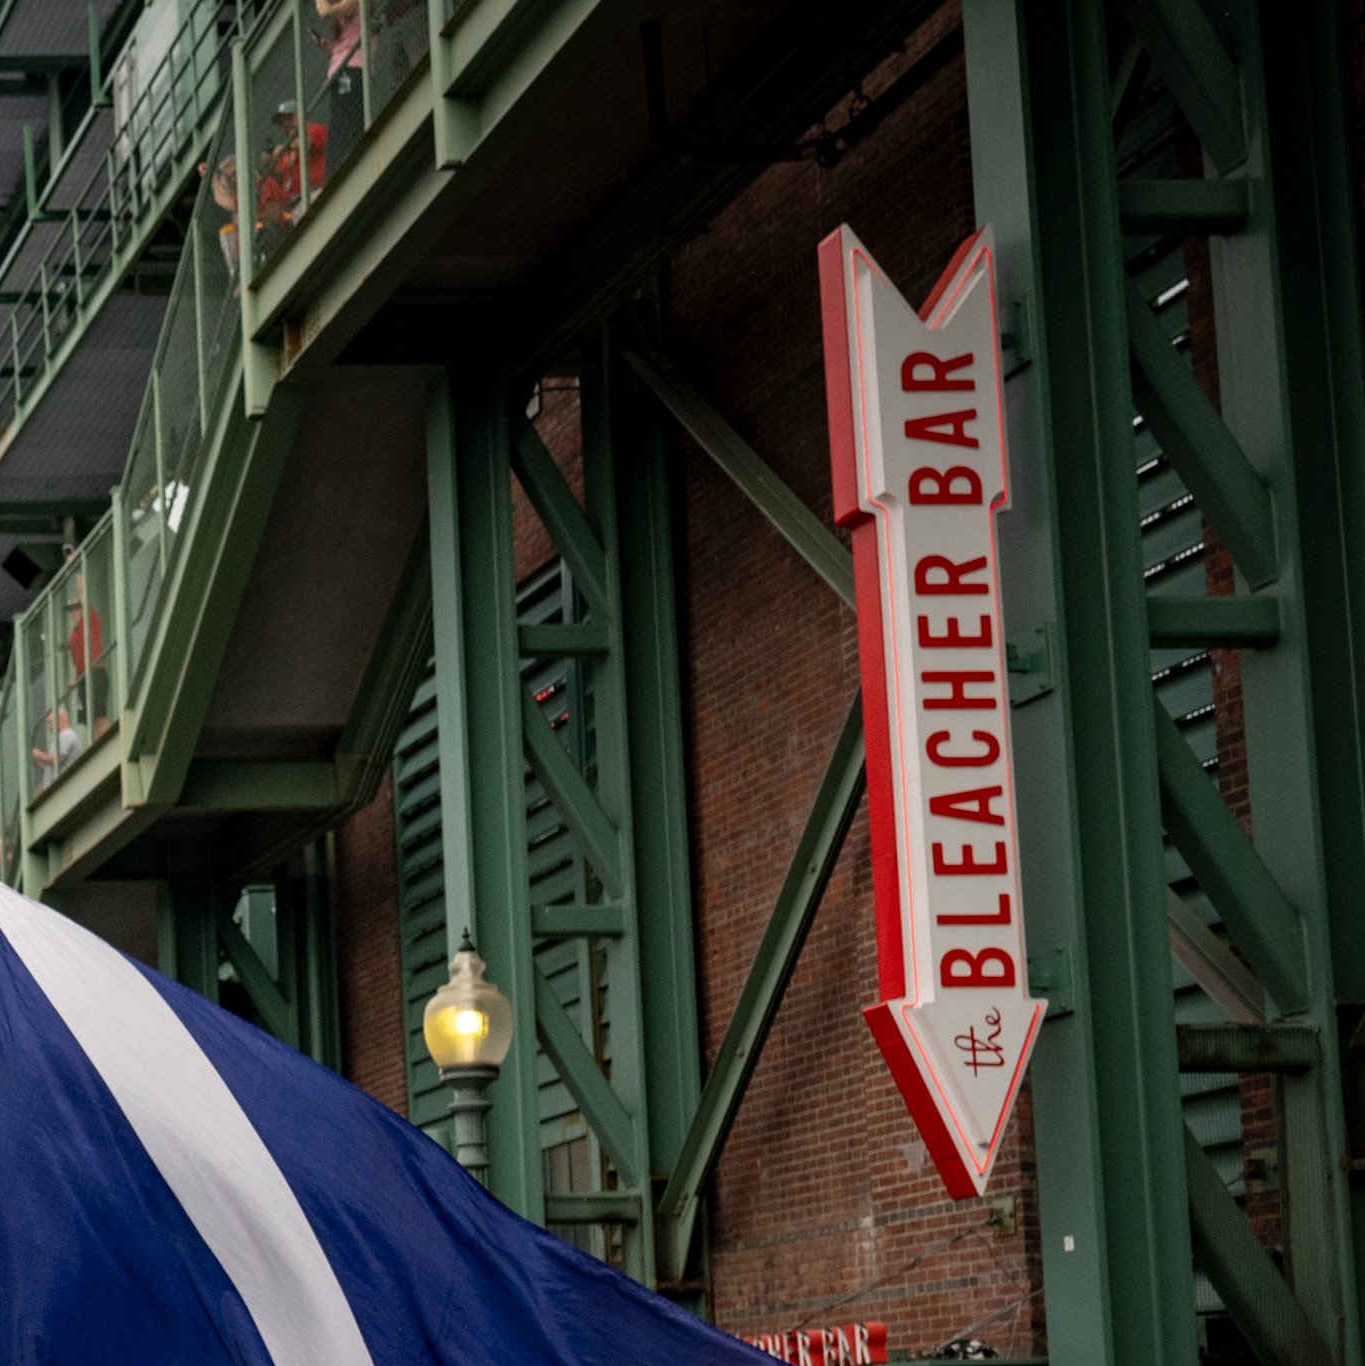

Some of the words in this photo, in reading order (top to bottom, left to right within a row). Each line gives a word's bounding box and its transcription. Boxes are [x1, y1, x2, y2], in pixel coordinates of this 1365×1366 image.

[900, 351, 983, 506] BAR
[914, 554, 1016, 988] BLEACHER
[954, 1006, 1006, 1077] the
